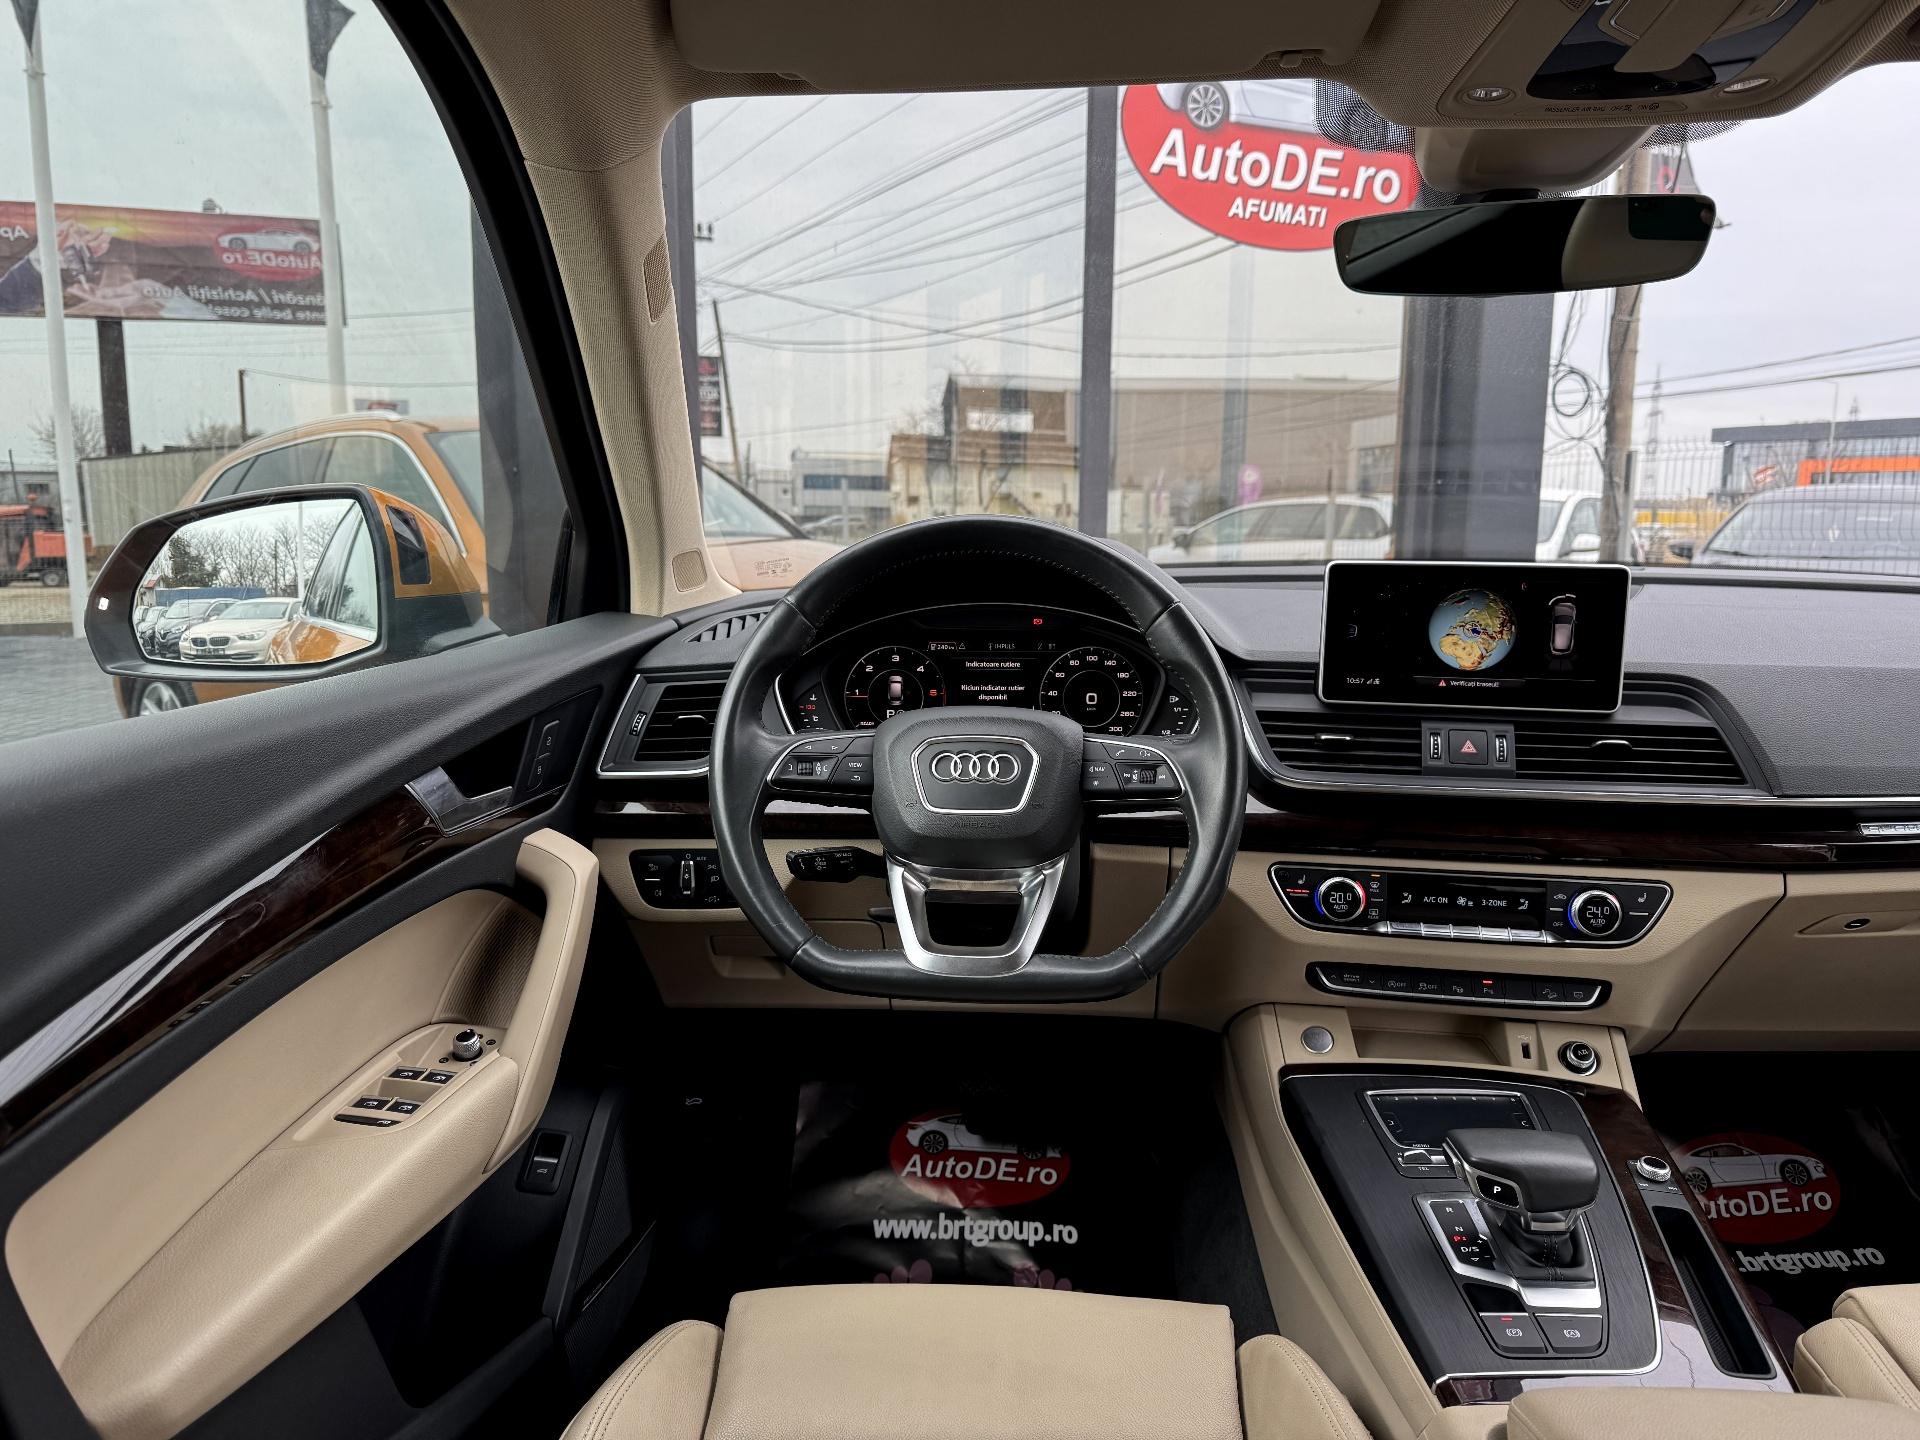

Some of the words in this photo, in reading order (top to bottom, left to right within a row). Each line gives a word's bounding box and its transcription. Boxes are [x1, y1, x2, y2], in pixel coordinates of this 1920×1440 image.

[1150, 128, 1402, 204] AutoDE.ro
[1228, 197, 1327, 228] AFUMATI
[1086, 693, 1097, 704] 0
[886, 710, 895, 719] P
[902, 1154, 1058, 1186] AutoDE.ro
[1703, 1188, 1833, 1220] utoDE.ro
[873, 1213, 1078, 1247] www.brtgroup.ro
[1738, 1247, 1886, 1274] .brtgroup.ro
